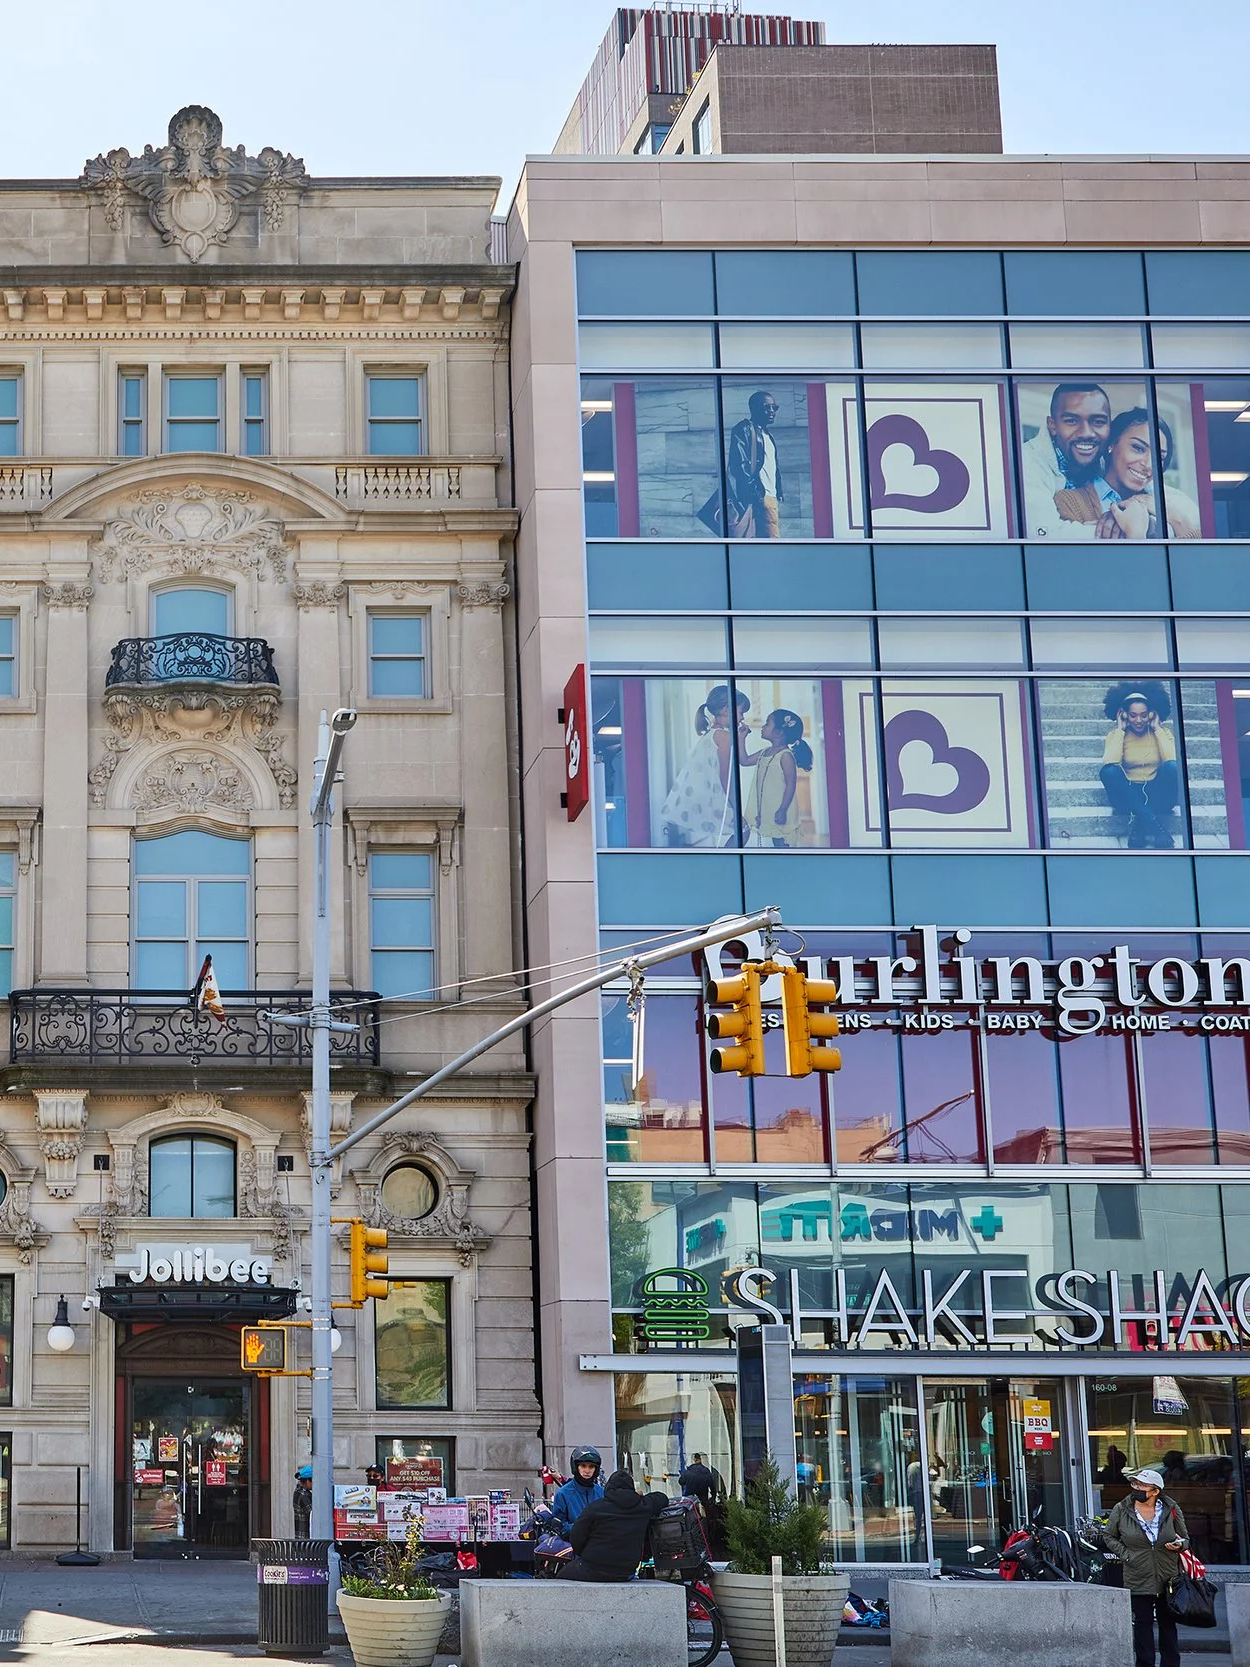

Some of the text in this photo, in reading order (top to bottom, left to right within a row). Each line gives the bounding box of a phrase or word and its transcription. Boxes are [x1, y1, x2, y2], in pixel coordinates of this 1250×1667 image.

[905, 1014, 953, 1029] KIDS
[987, 1014, 1044, 1029] BABY
[1112, 1015, 1171, 1030] HOME
[129, 1247, 268, 1285] Jollibee
[736, 1267, 1250, 1344] SHAKE SHA
[1028, 1418, 1048, 1427] BBQ
